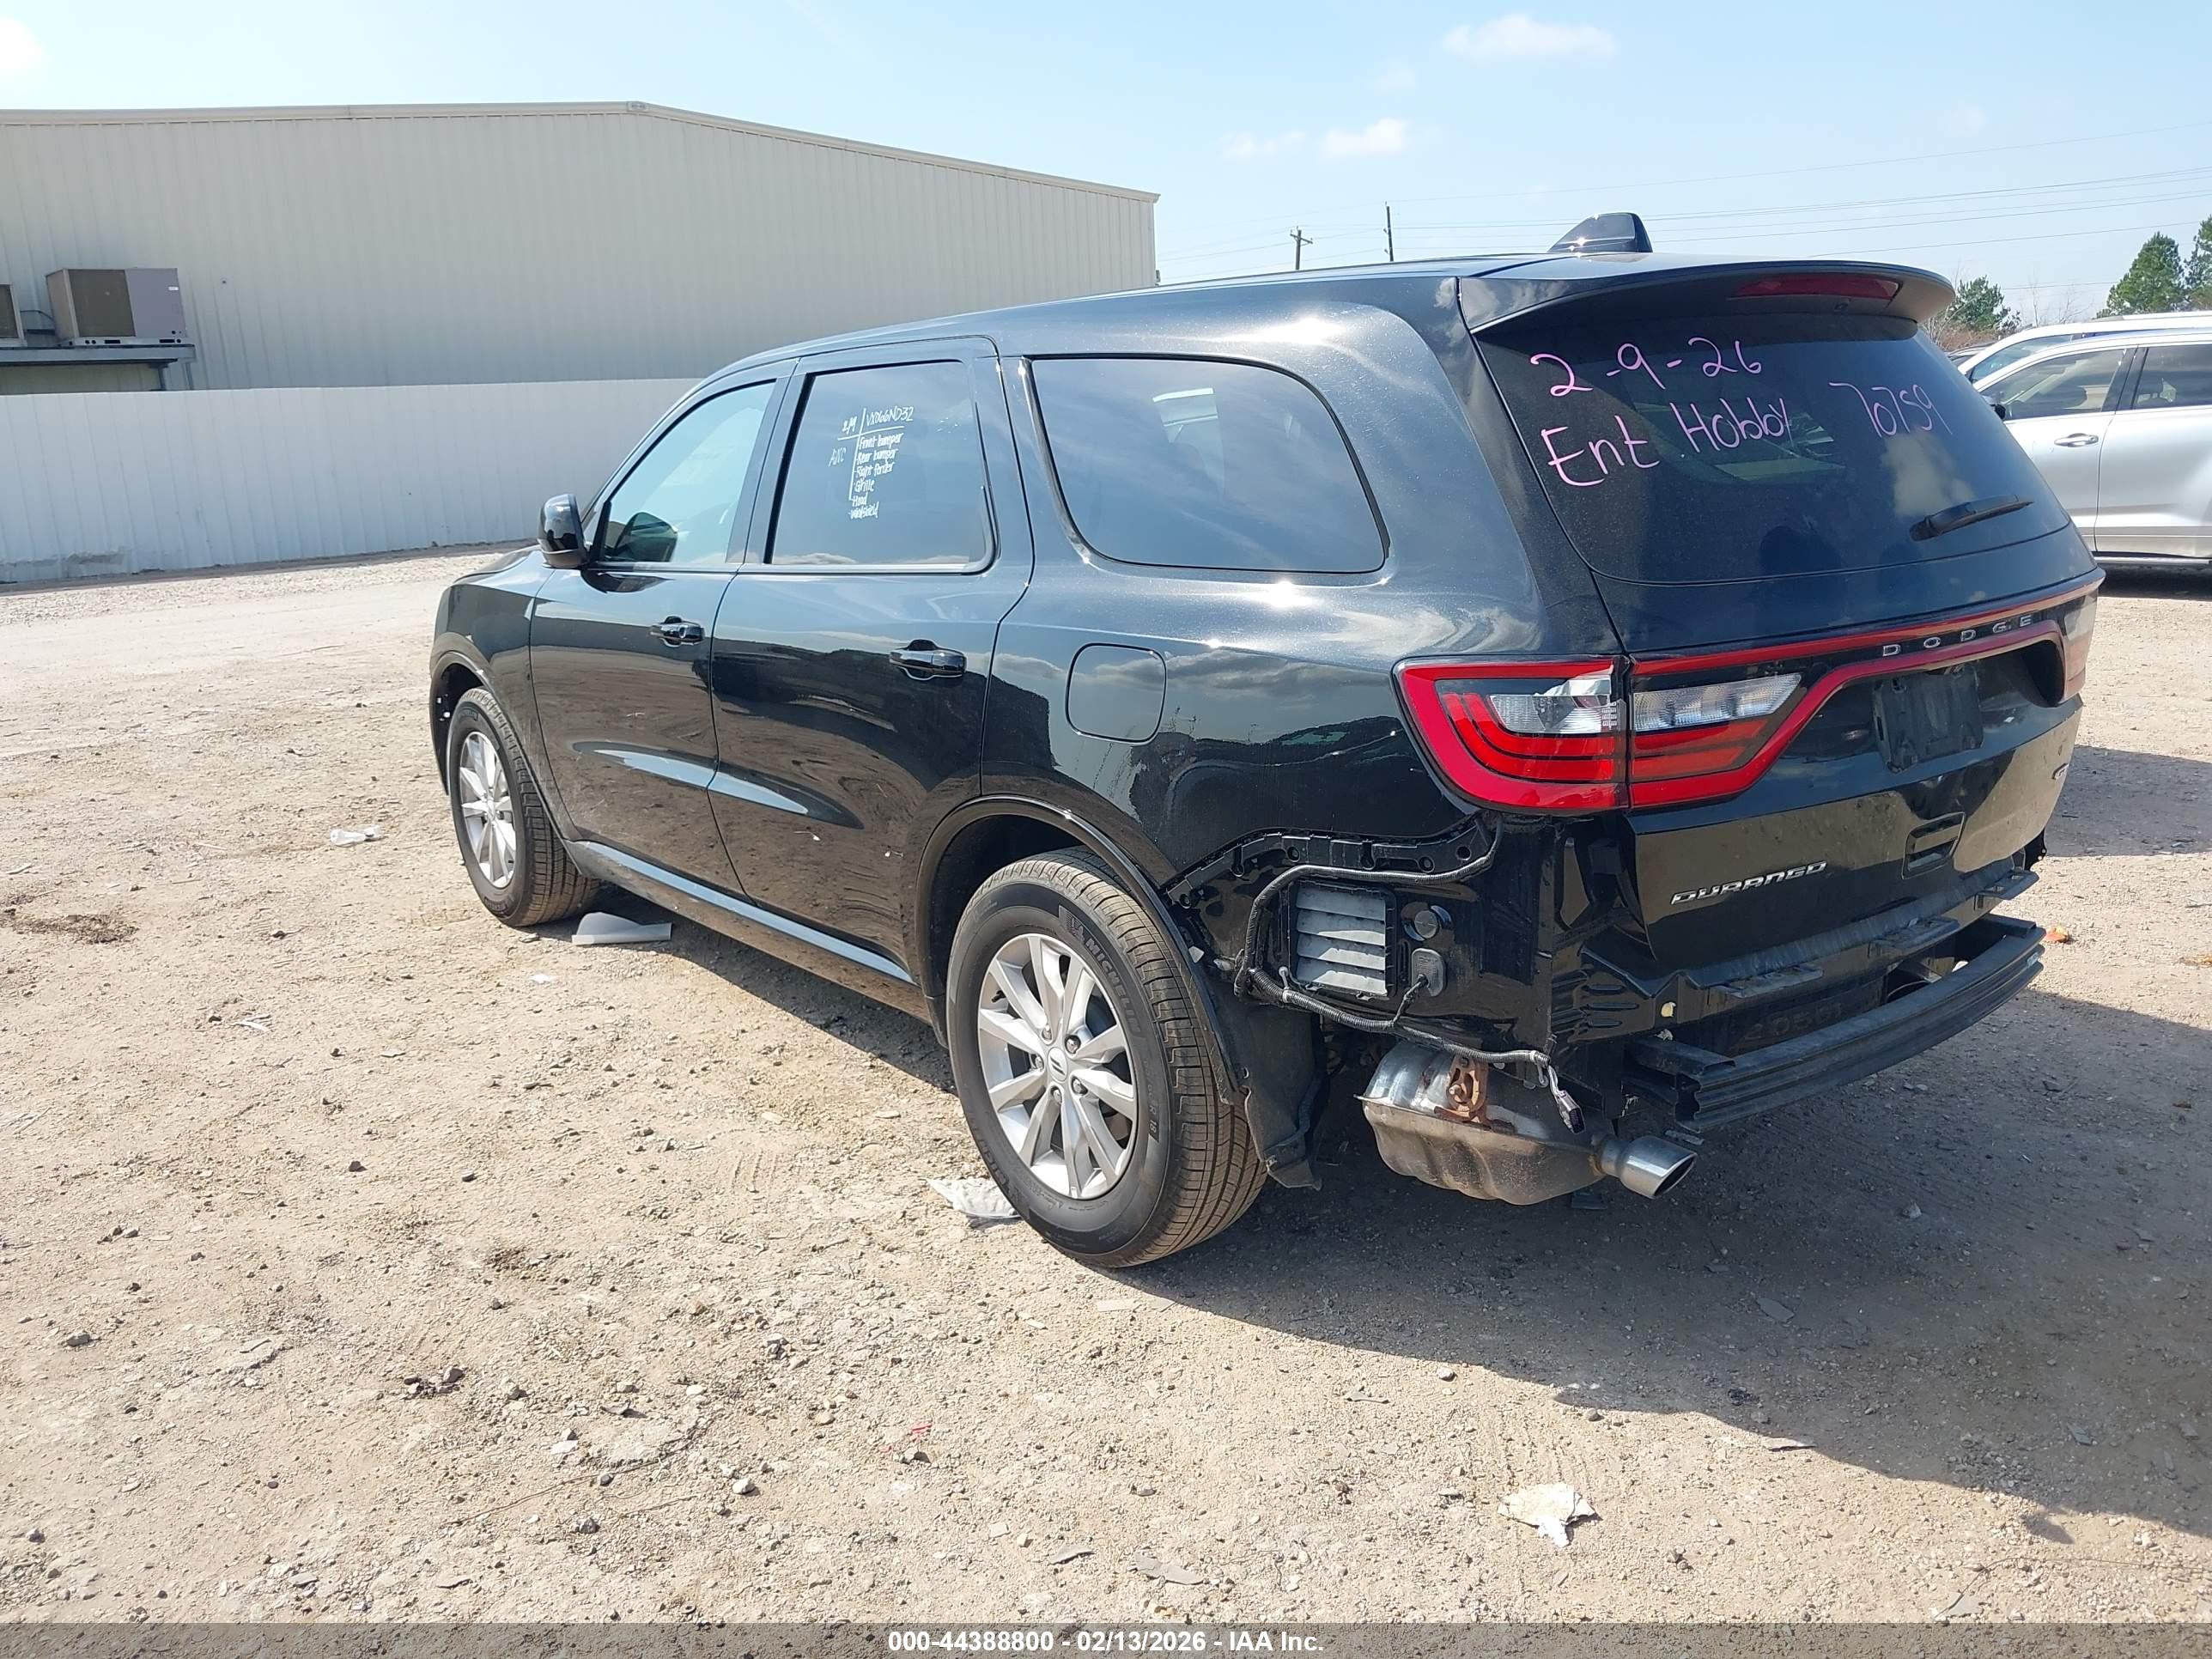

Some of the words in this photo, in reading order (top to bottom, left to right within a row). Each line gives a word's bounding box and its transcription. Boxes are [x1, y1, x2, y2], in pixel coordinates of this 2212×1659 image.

[1530, 337, 1761, 397] 2-9-26
[1540, 415, 1660, 486] Ent
[1881, 613, 2034, 657] DODGE
[1670, 860, 1827, 905] DURANGO
[1085, 937, 1142, 1036] MICHELIN
